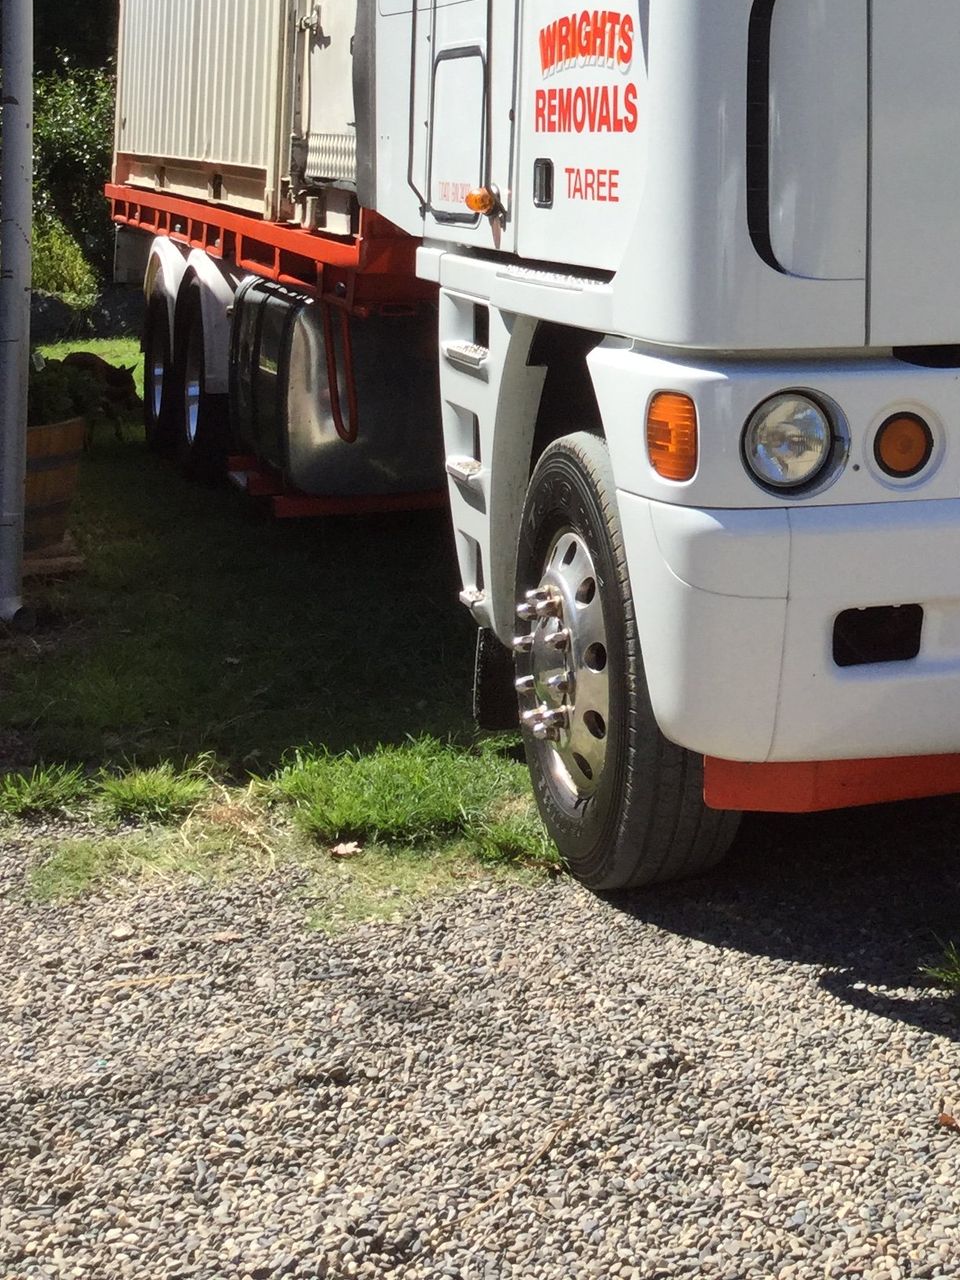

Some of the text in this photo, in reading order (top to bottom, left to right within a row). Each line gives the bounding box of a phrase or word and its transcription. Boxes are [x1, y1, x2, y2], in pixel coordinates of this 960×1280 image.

[538, 9, 634, 73] WRIGHTS
[534, 82, 638, 134] REMOVALS
[564, 167, 620, 203] TAREE
